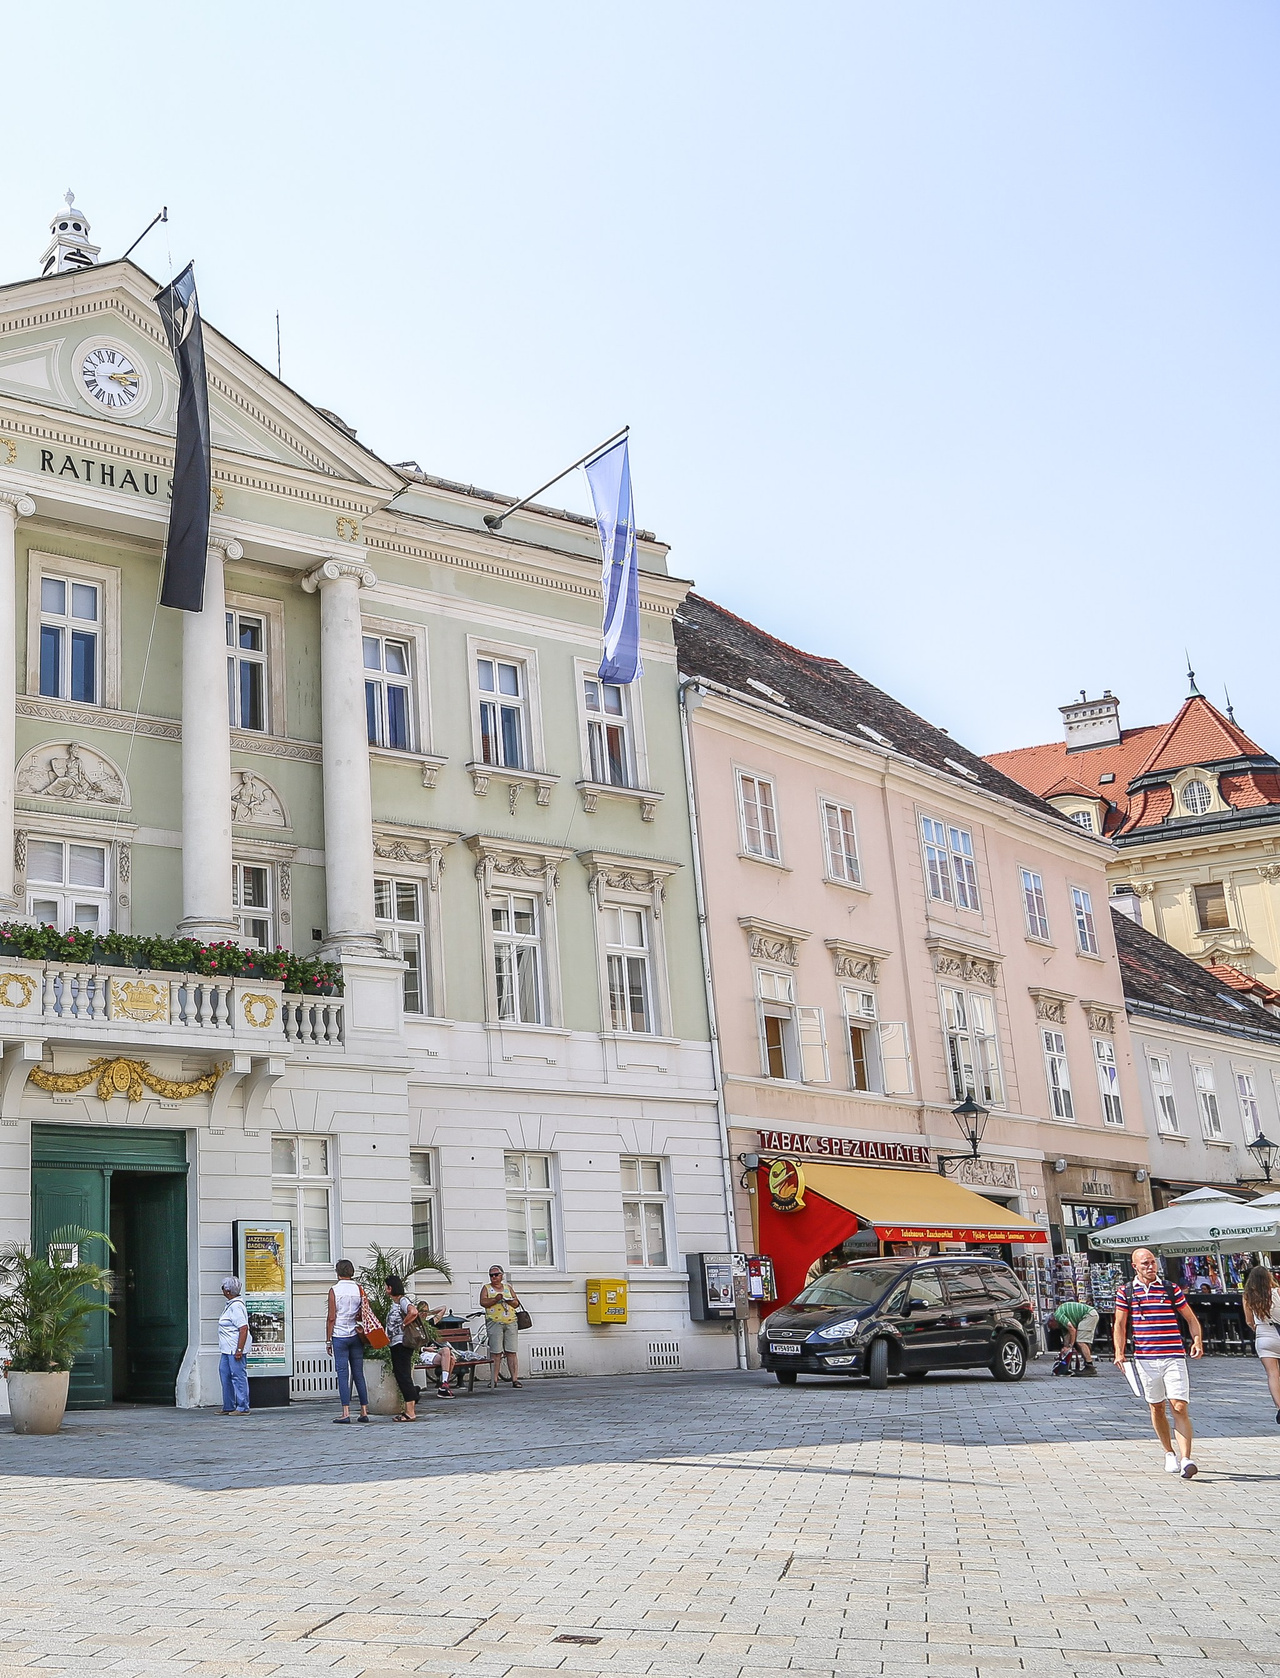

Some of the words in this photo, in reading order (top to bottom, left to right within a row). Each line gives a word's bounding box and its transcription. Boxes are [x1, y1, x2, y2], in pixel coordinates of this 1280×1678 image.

[105, 351, 116, 364] XII
[761, 1130, 813, 1152] TABAK
[821, 1137, 931, 1163] SPEZIALITÄTEN
[1221, 1226, 1274, 1236] RÖMERQUELLE
[1101, 1235, 1149, 1245] RÖMERQUELLE
